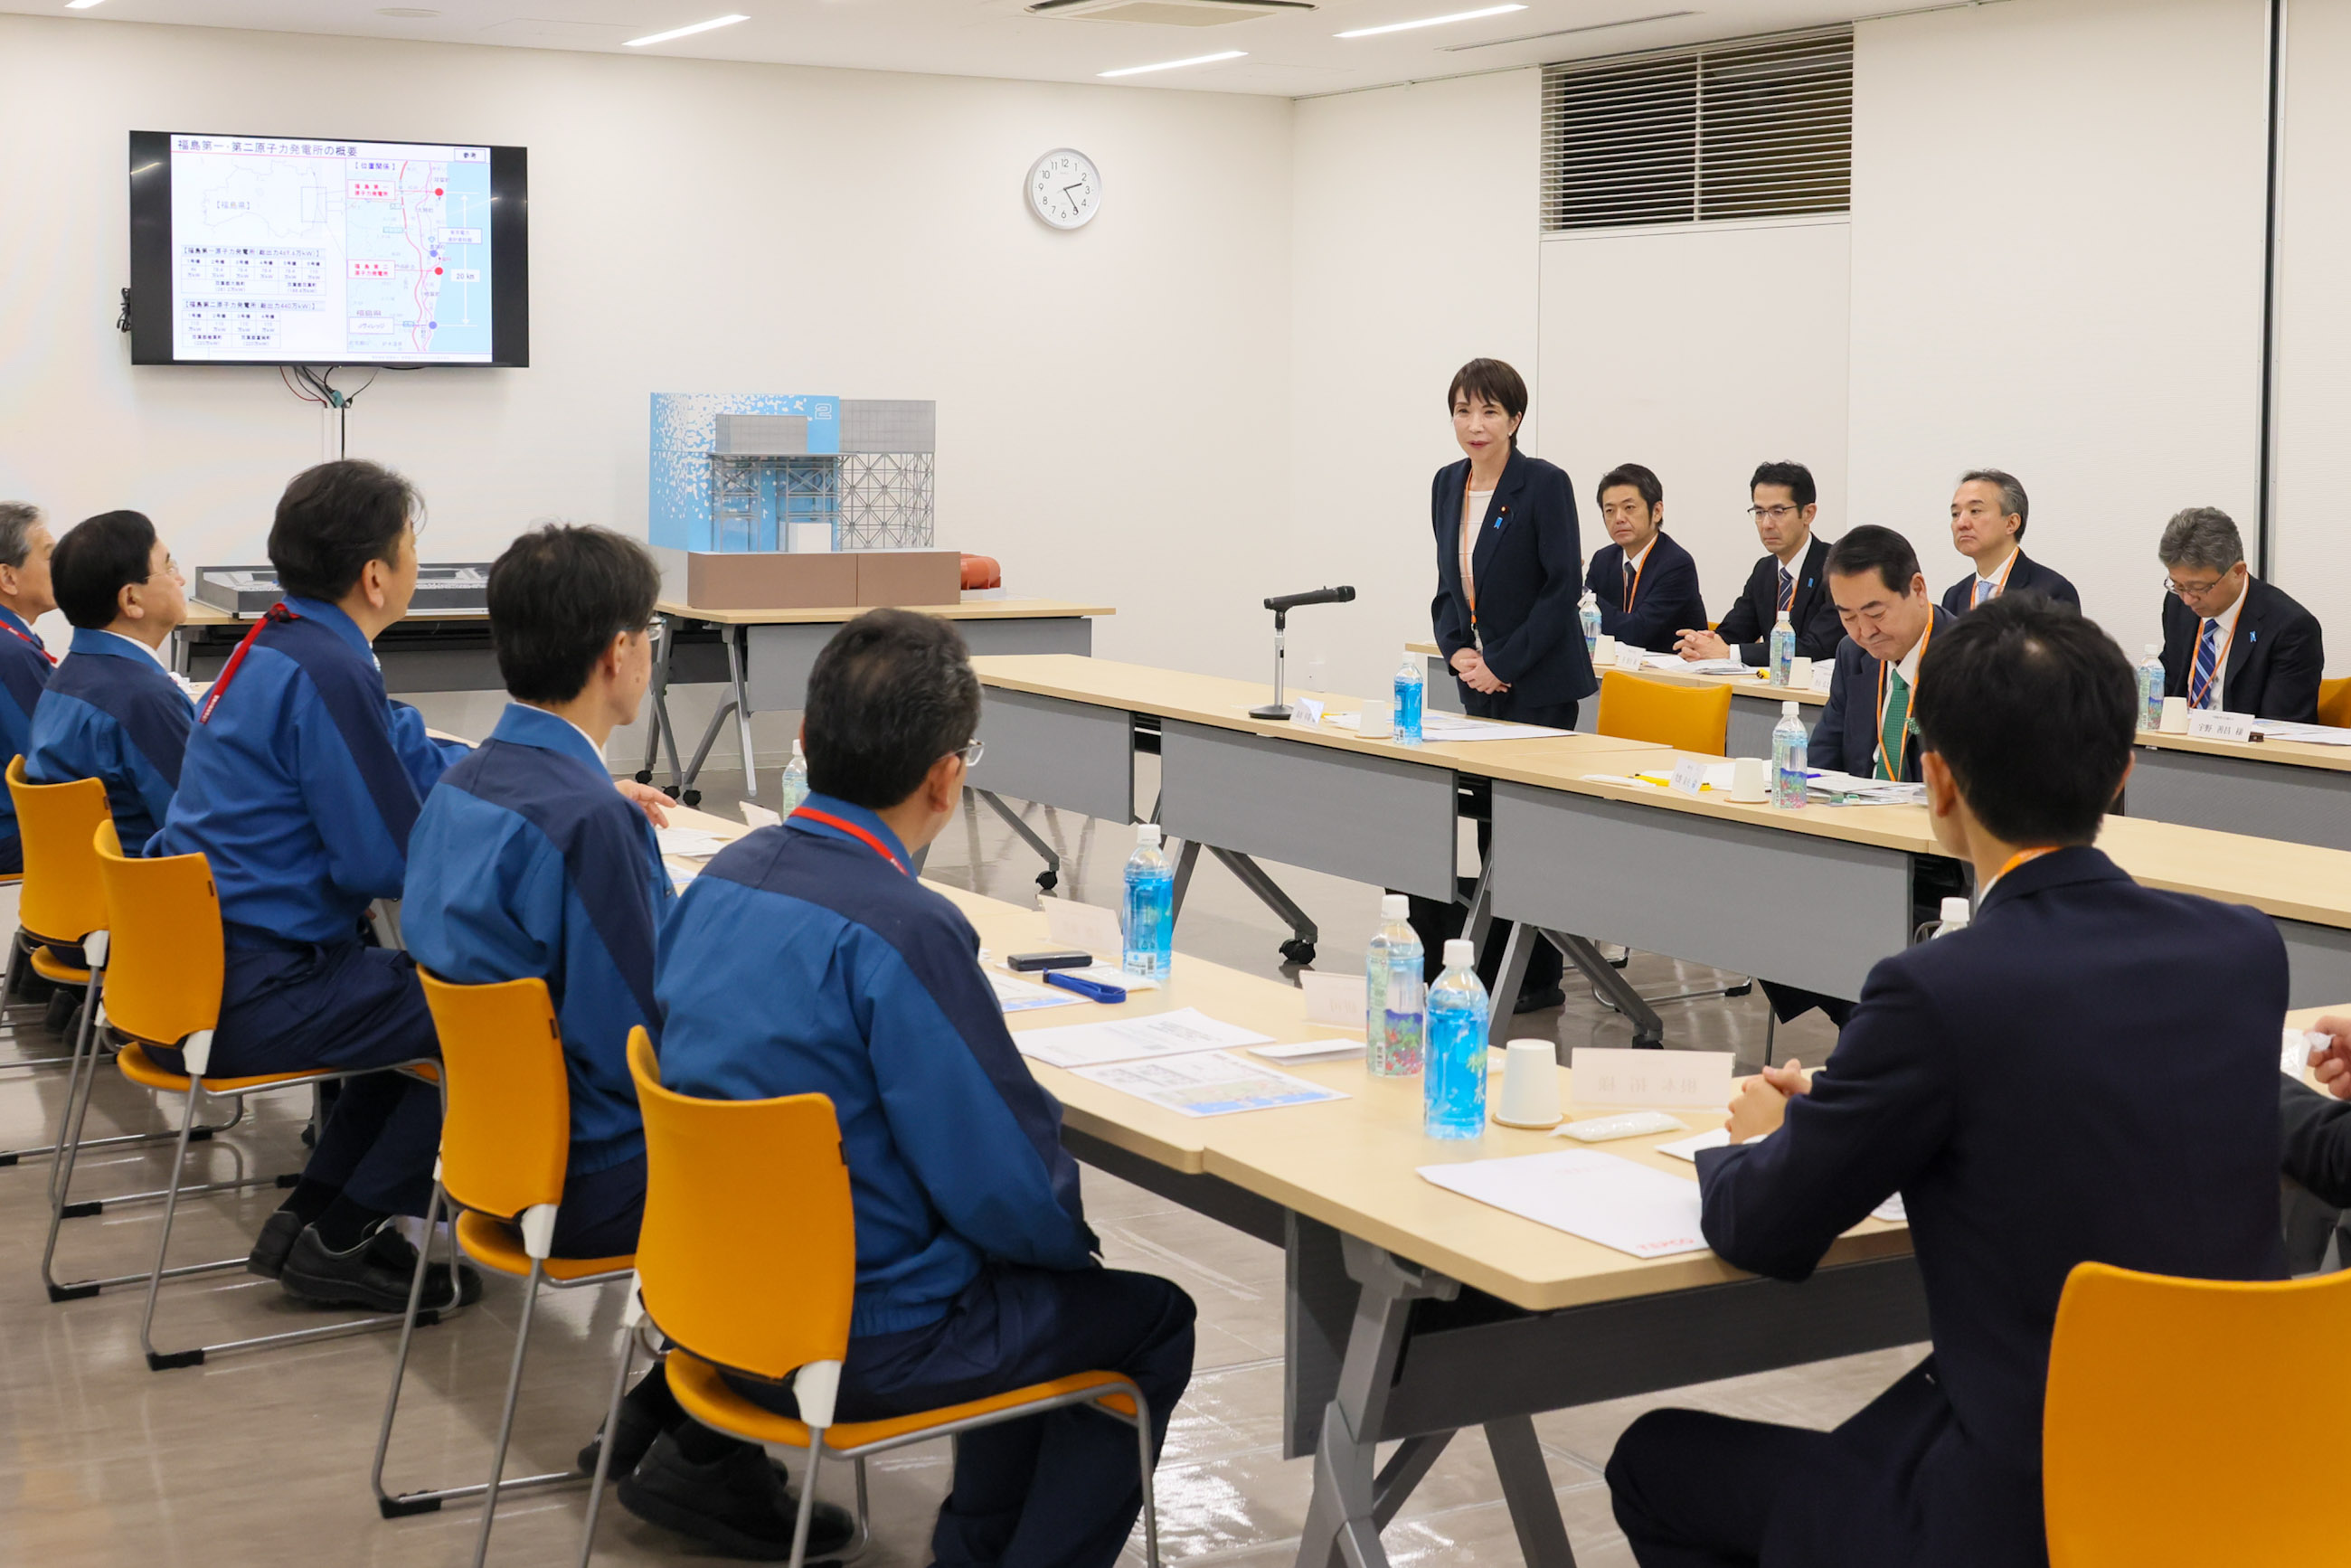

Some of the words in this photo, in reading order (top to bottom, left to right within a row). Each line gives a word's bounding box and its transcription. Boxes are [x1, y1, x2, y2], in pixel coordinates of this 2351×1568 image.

[1051, 162, 1057, 170] 11
[1062, 159, 1069, 167] 12
[1074, 163, 1077, 171] 1
[1042, 170, 1050, 179] 10
[1081, 173, 1087, 181] 2
[1038, 183, 1043, 192] 9
[1085, 186, 1091, 194] 3
[1043, 196, 1047, 204] 8
[1081, 199, 1086, 207] 4
[1061, 210, 1066, 218] 6
[1073, 207, 1079, 215] 5
[815, 403, 832, 420] 2
